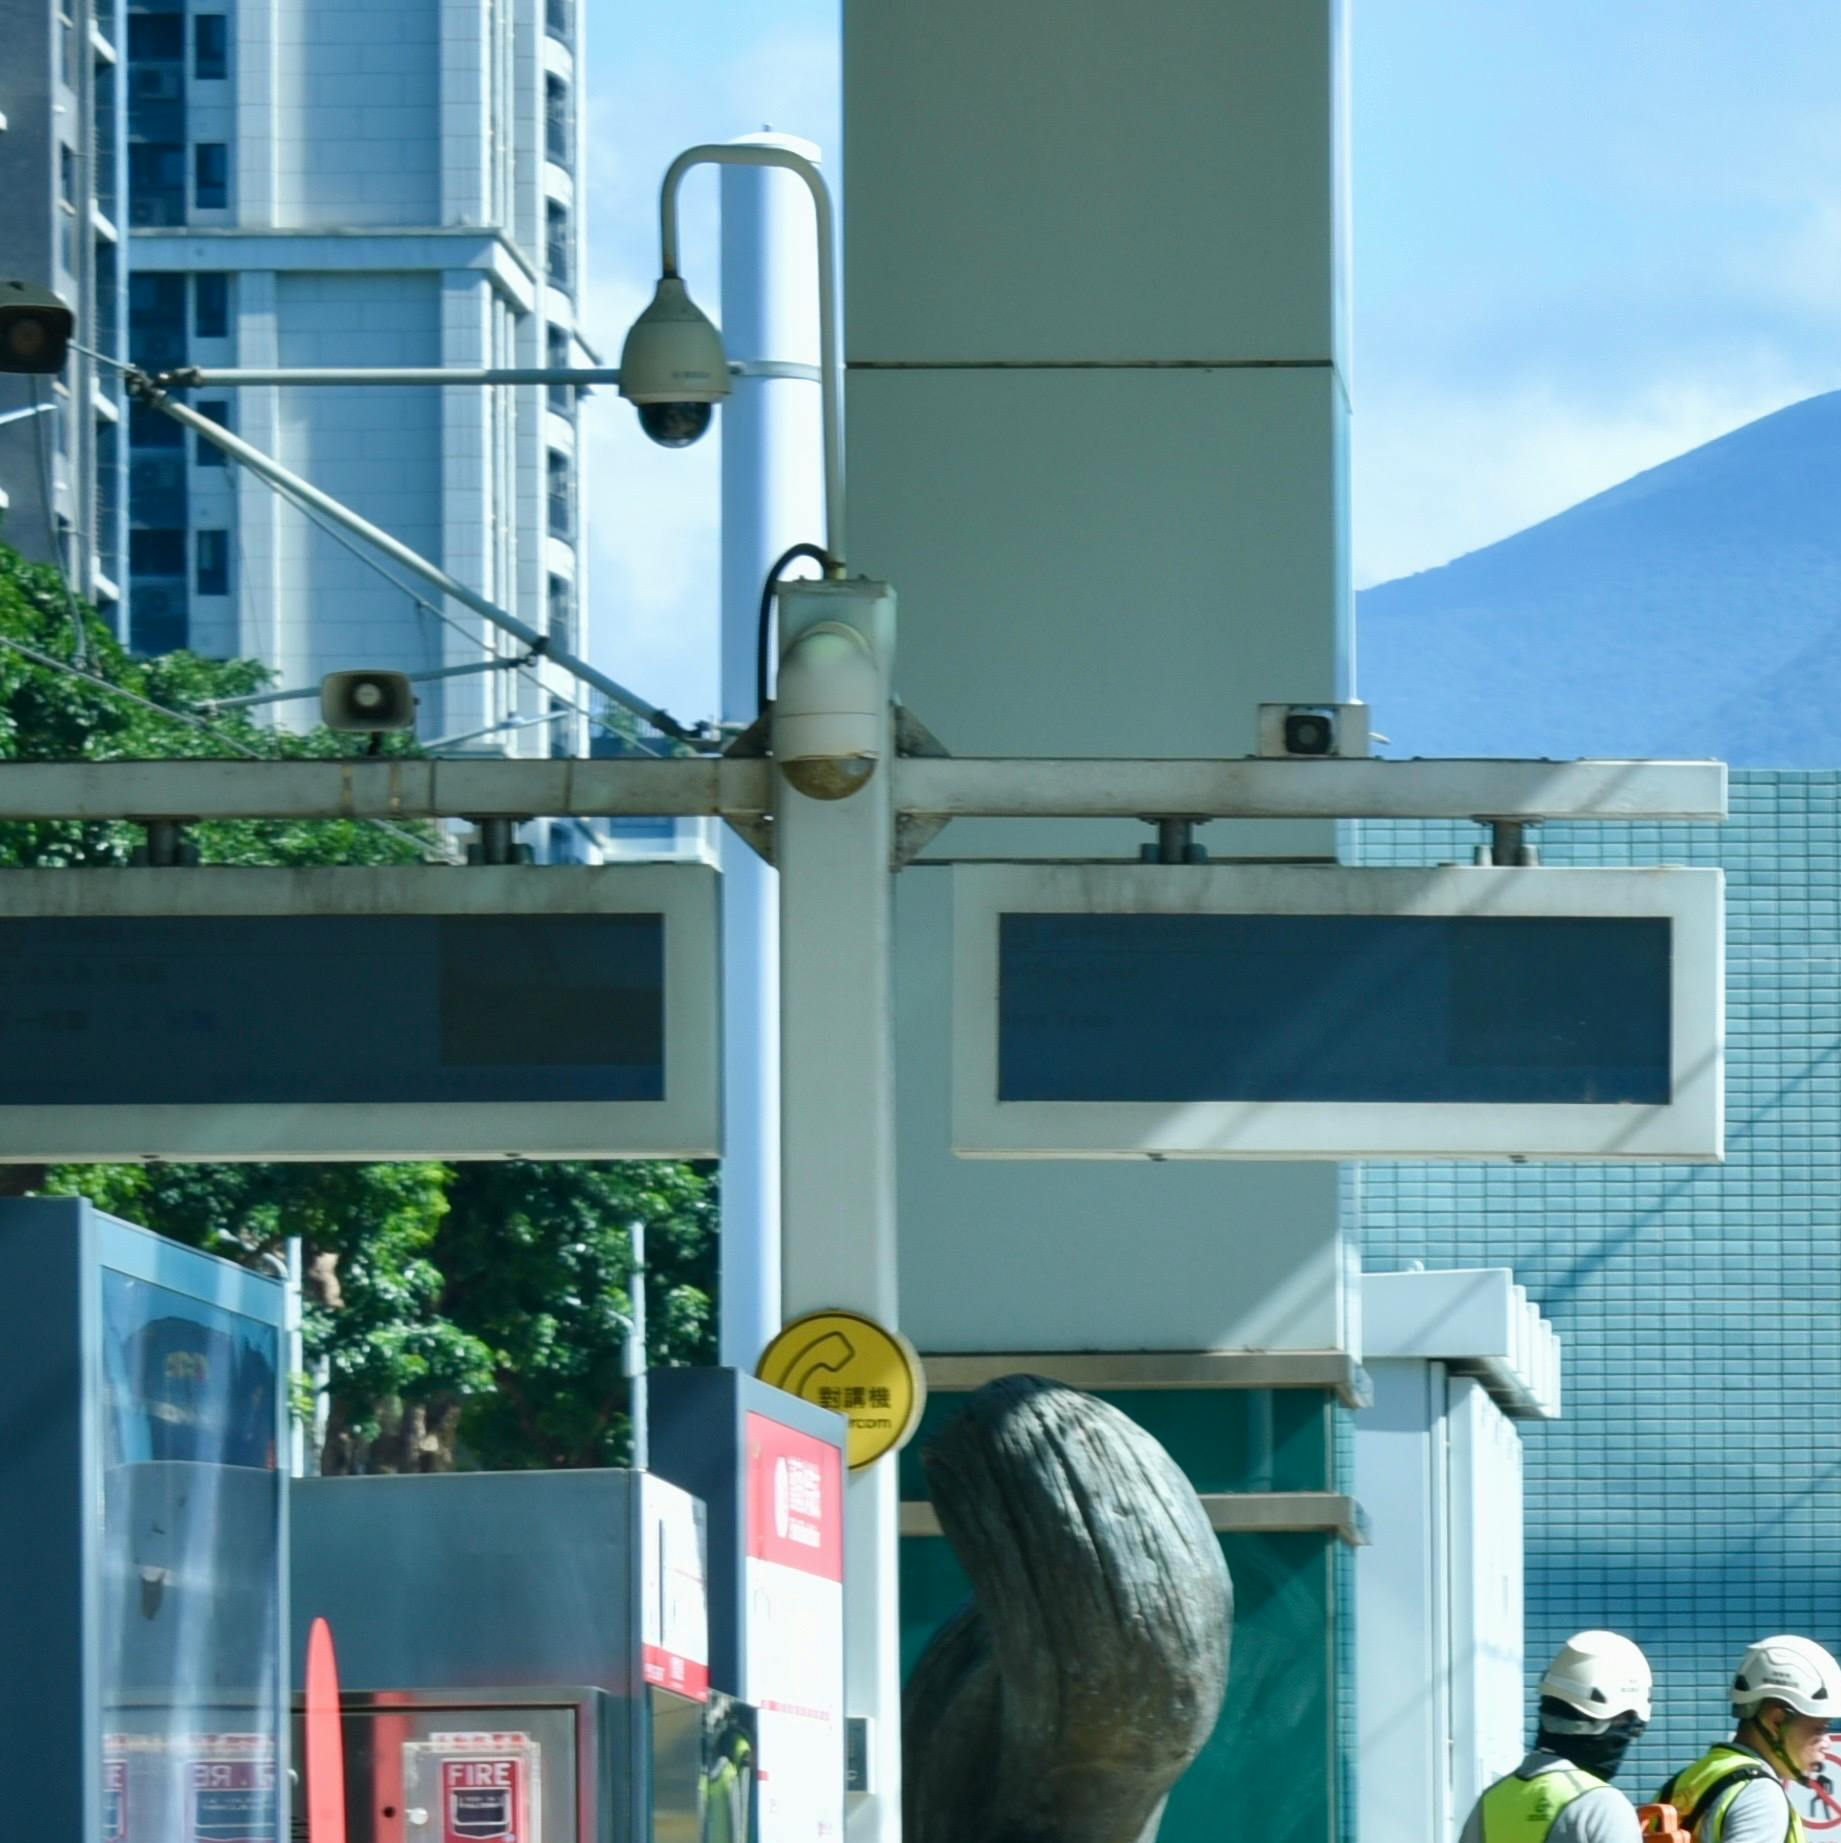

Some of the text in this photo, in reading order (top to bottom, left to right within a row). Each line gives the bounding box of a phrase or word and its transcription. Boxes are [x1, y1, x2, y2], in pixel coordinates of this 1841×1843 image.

[818, 1387, 891, 1409] 對講機
[848, 1418, 892, 1429] rcom
[448, 1763, 512, 1786] FIRE
